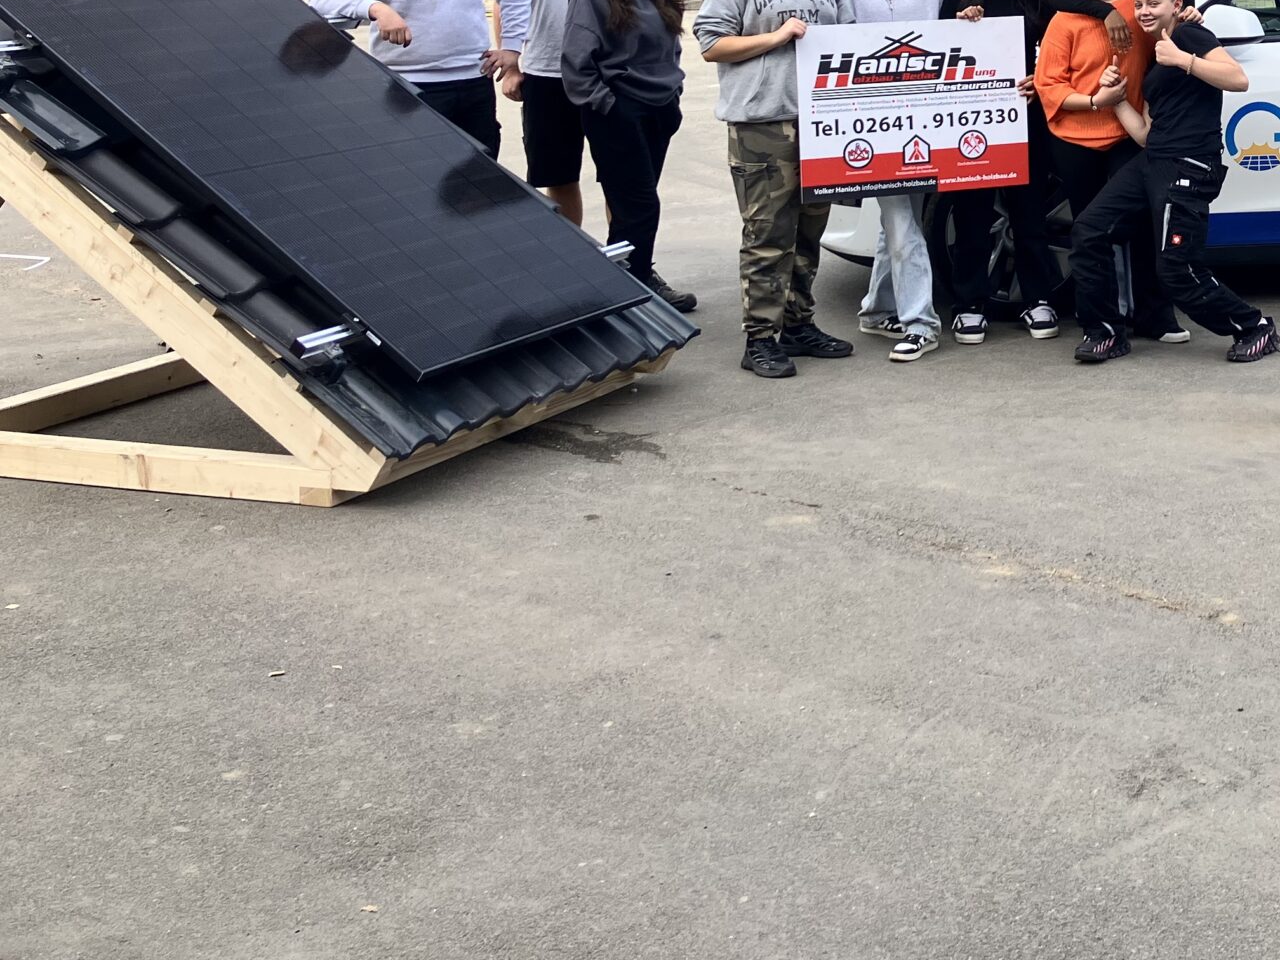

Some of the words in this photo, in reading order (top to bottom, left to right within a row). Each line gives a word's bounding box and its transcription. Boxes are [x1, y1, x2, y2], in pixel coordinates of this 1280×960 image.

[814, 47, 977, 89] Hanisch
[935, 79, 1011, 93] Restauration
[811, 119, 846, 137] Tel.
[853, 115, 914, 134] 02641
[933, 108, 1019, 129] 9167330
[814, 187, 835, 196] Volker
[835, 184, 861, 194] Hanisch
